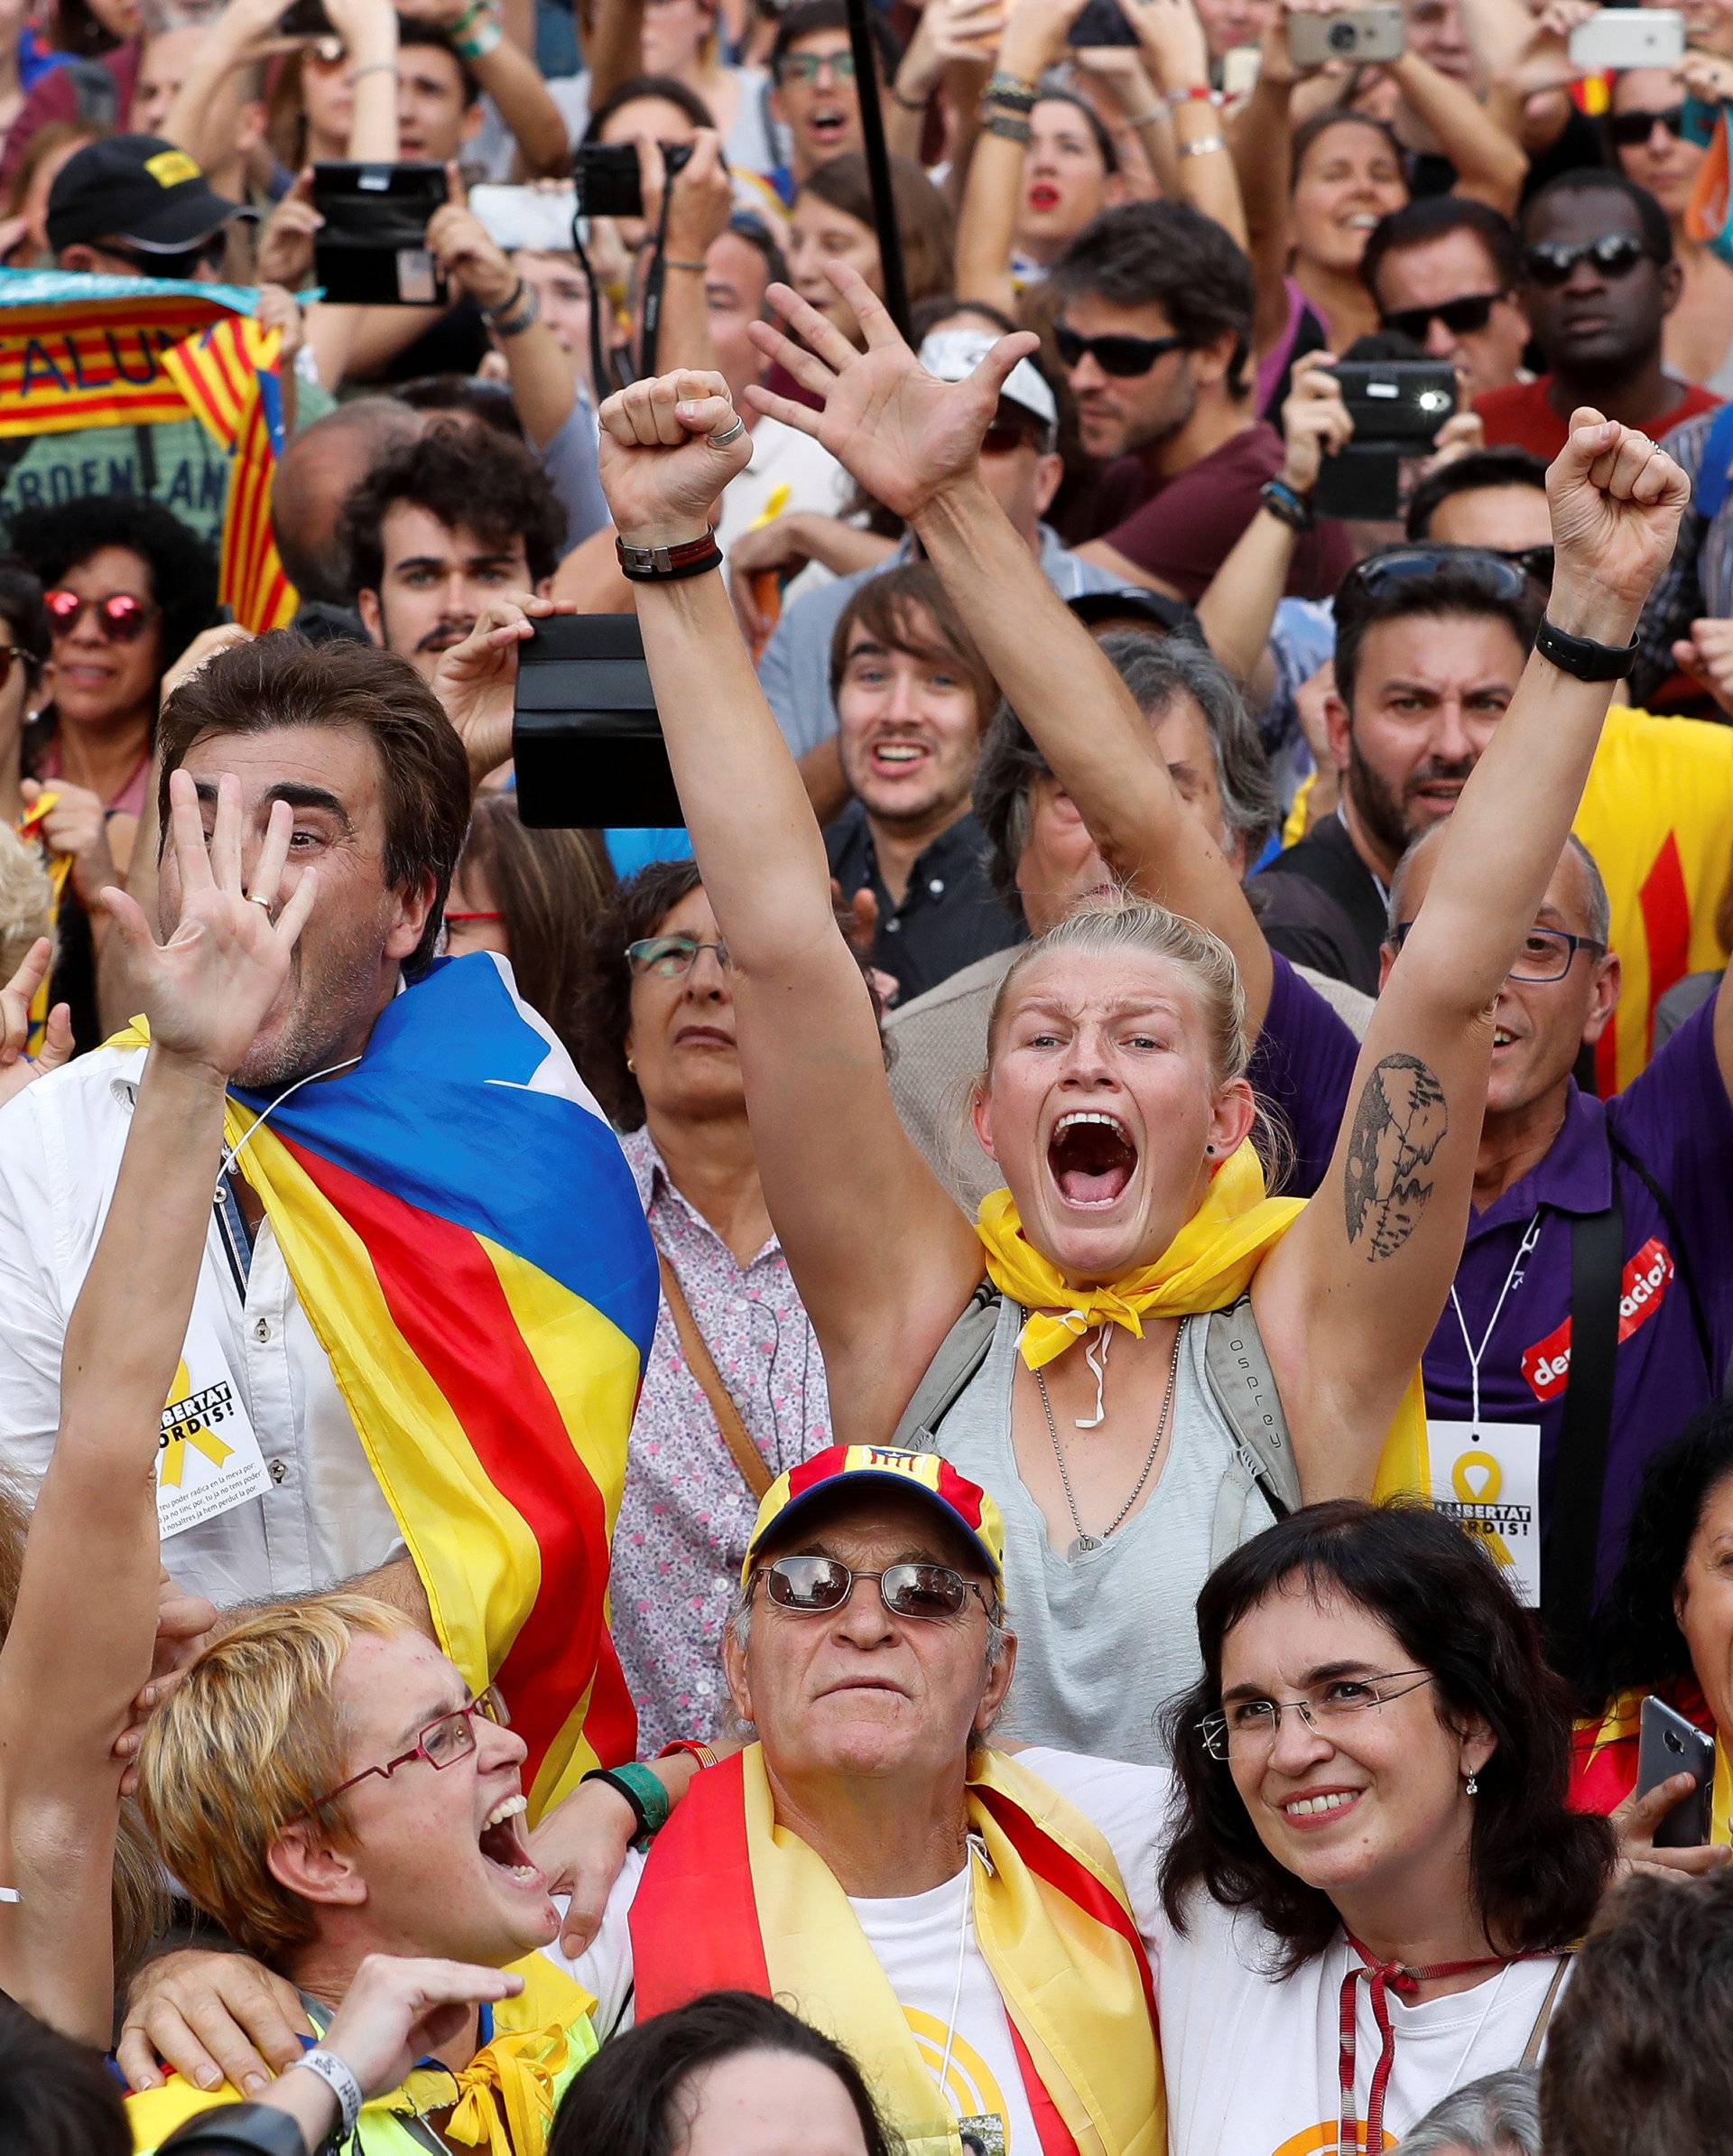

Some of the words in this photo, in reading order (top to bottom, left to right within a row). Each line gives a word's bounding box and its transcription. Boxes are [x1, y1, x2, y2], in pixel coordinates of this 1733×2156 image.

[0, 328, 195, 397] ALU
[159, 1382, 228, 1429] BERTAT
[159, 1401, 235, 1449] ORDIS!
[171, 1494, 189, 1507] poder
[220, 1486, 229, 1495] no
[203, 1503, 218, 1514] hem
[218, 1493, 239, 1509] perdut
[1467, 1520, 1528, 1537] RDIS!
